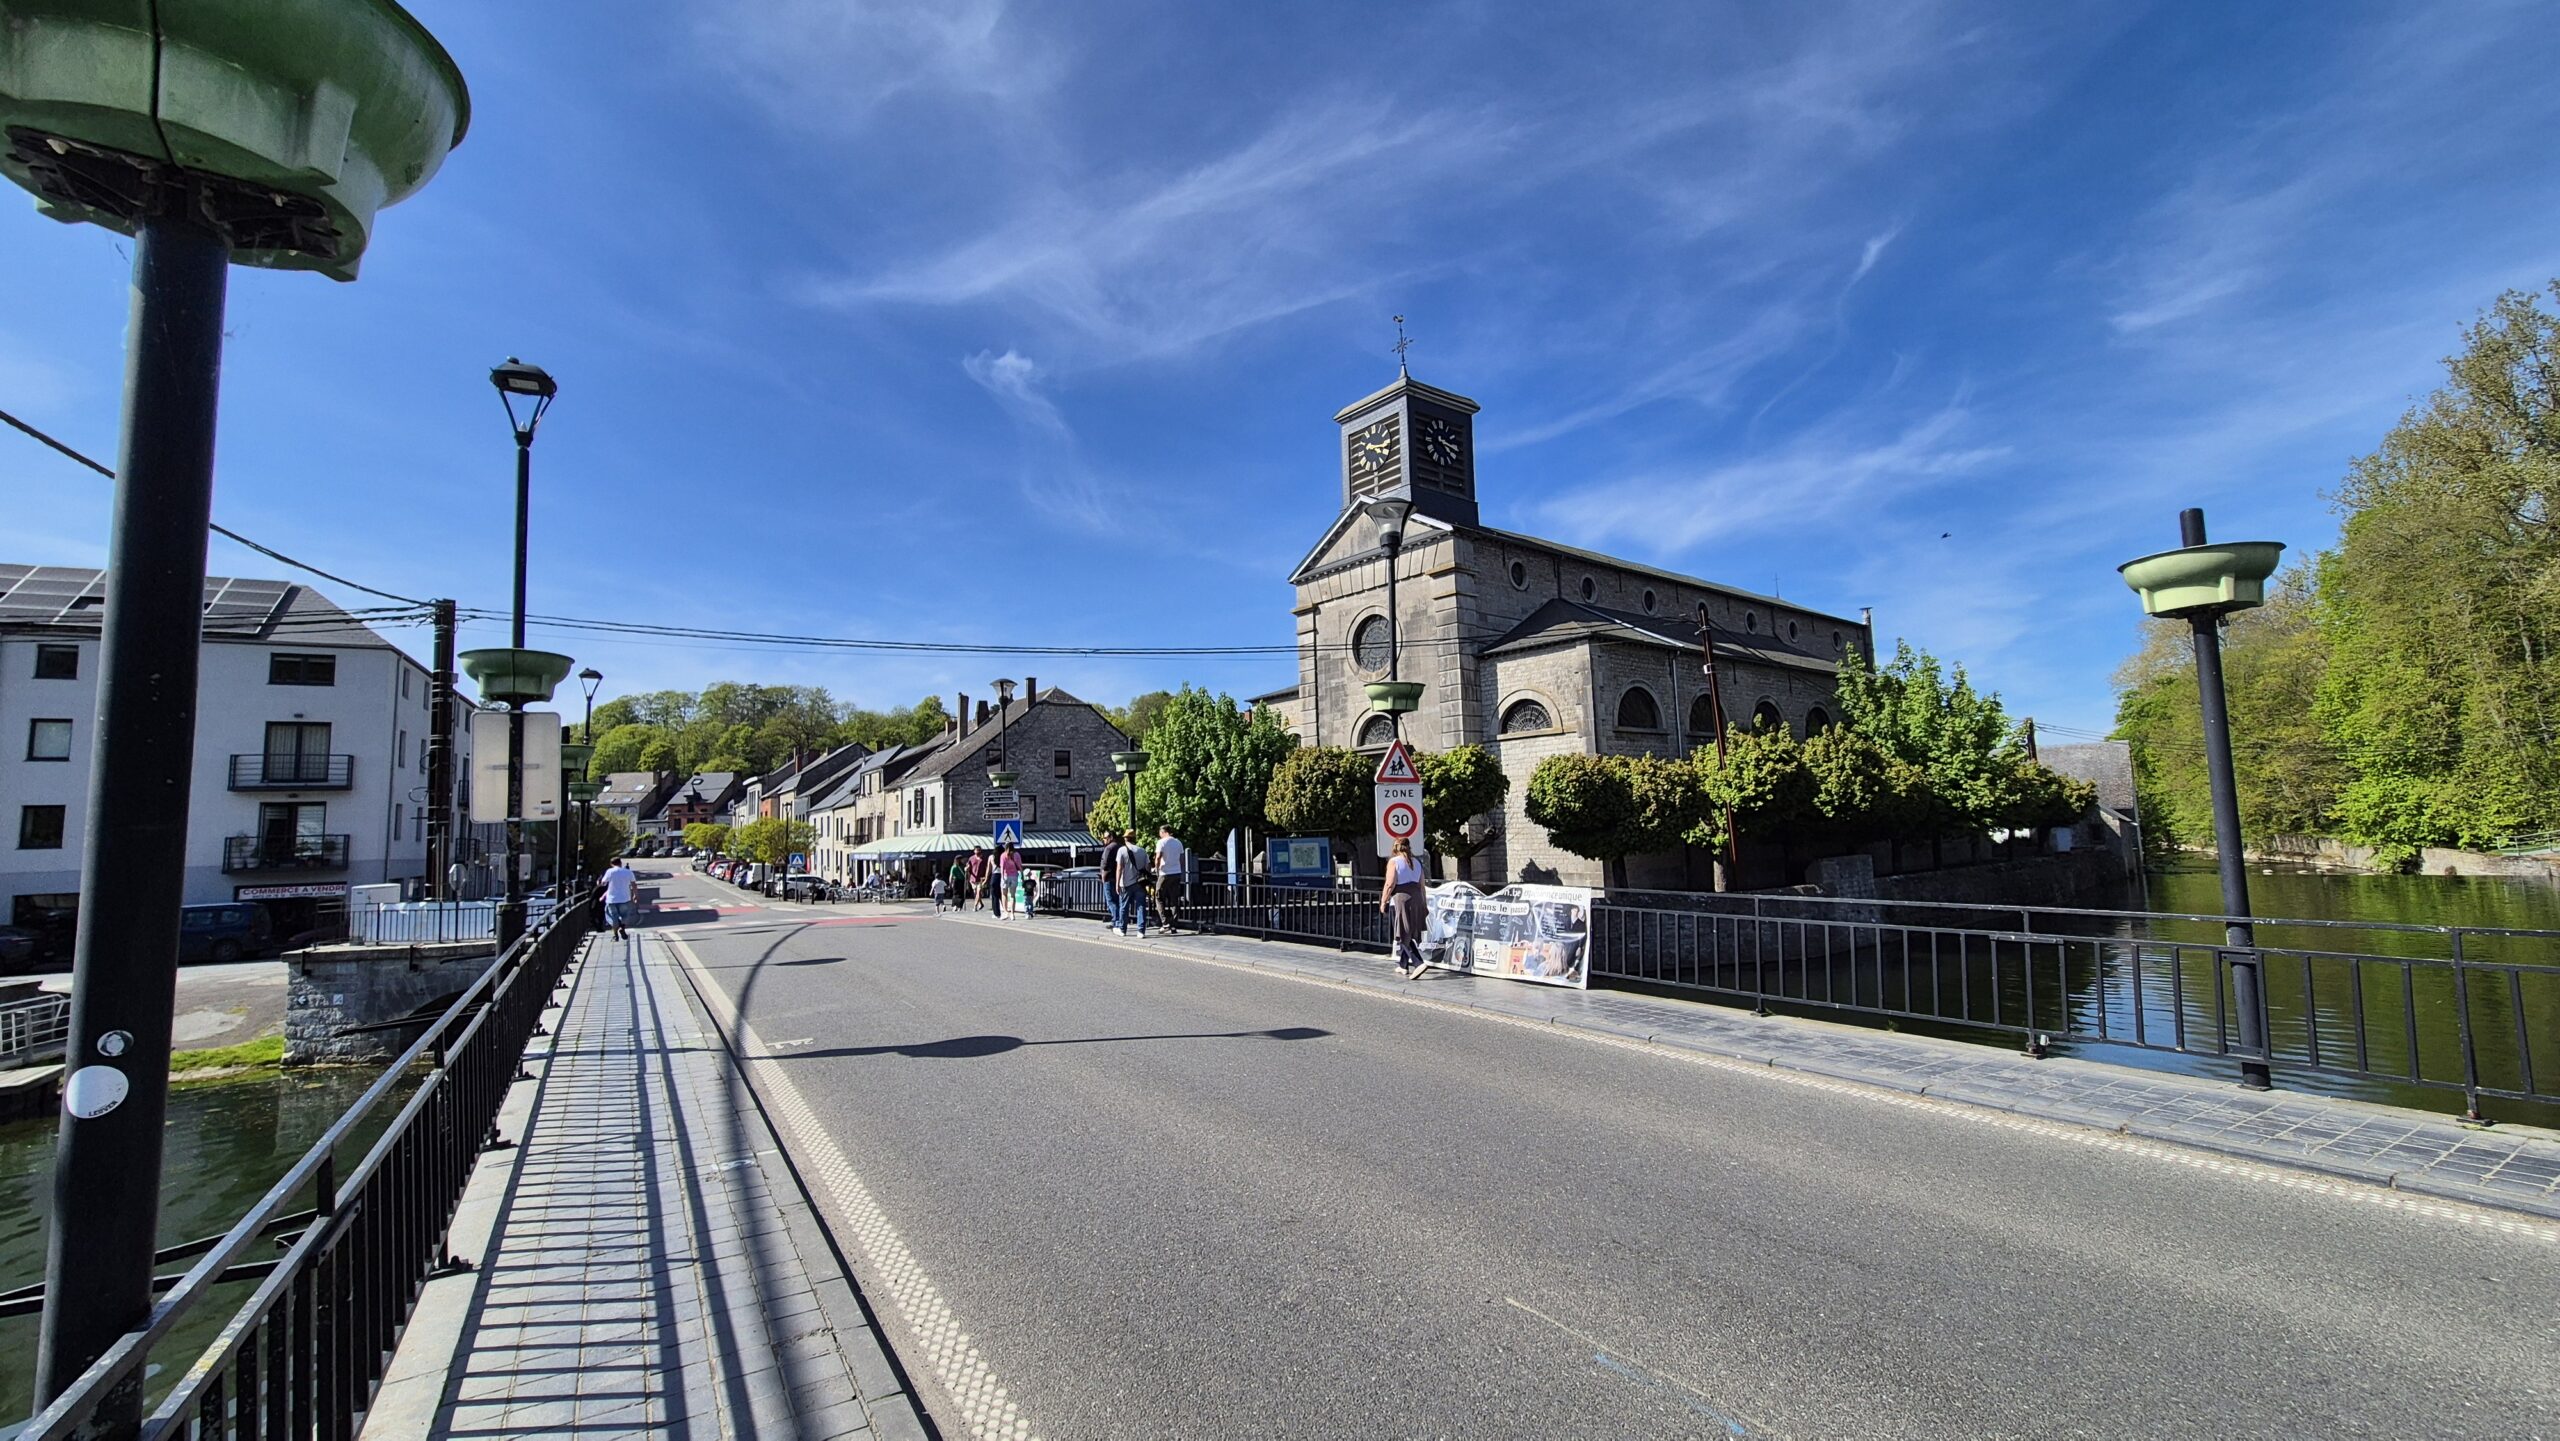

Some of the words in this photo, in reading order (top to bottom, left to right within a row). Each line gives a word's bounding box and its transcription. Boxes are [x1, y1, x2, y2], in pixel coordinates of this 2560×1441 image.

[1384, 789, 1414, 798] ZONE
[1392, 814, 1409, 827] 30
[243, 887, 298, 895] COMMERCE
[311, 884, 345, 892] VENDRE
[1478, 901, 1497, 912] dans
[1499, 904, 1508, 913] le
